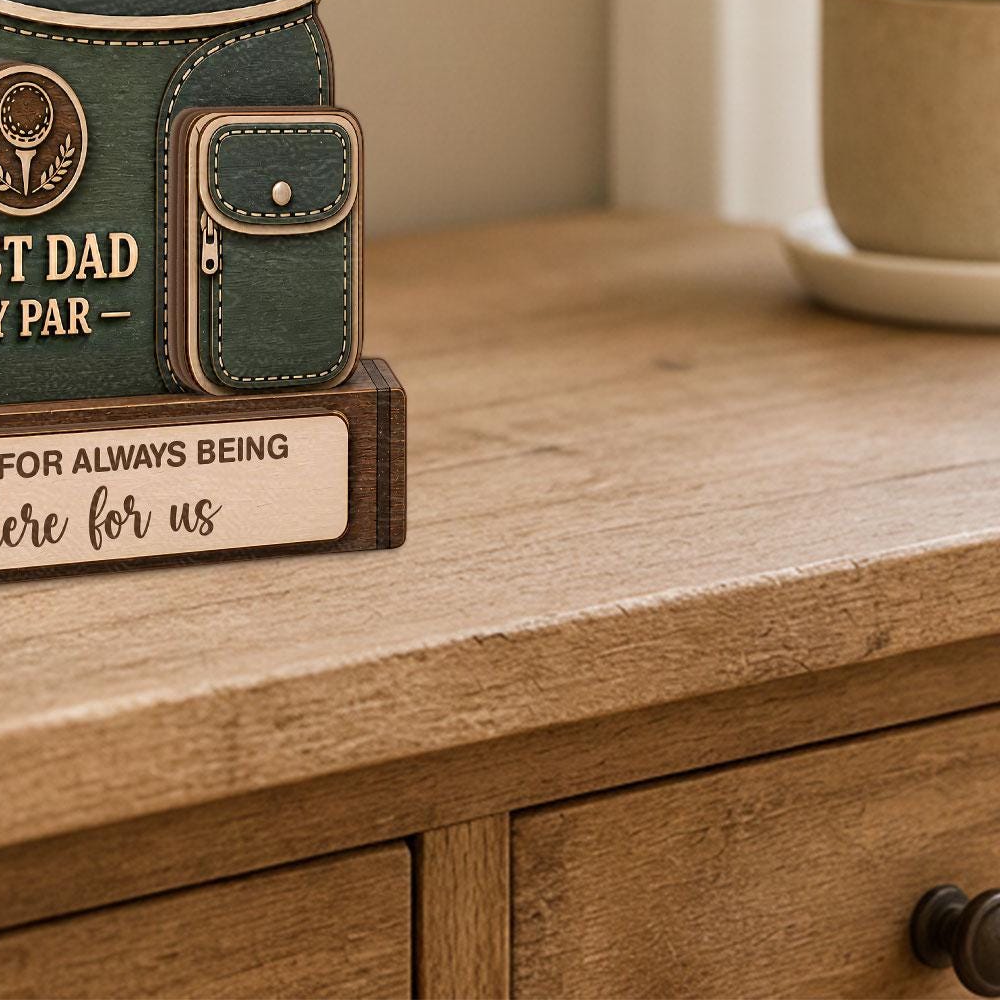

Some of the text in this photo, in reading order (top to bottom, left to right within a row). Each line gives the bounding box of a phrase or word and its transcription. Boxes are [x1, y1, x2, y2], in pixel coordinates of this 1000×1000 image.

[46, 232, 139, 281] DAD
[20, 297, 92, 337] PAR
[72, 439, 187, 475] ALWAYS
[197, 433, 290, 466] BEING
[88, 485, 152, 551] for
[170, 497, 223, 537] us
